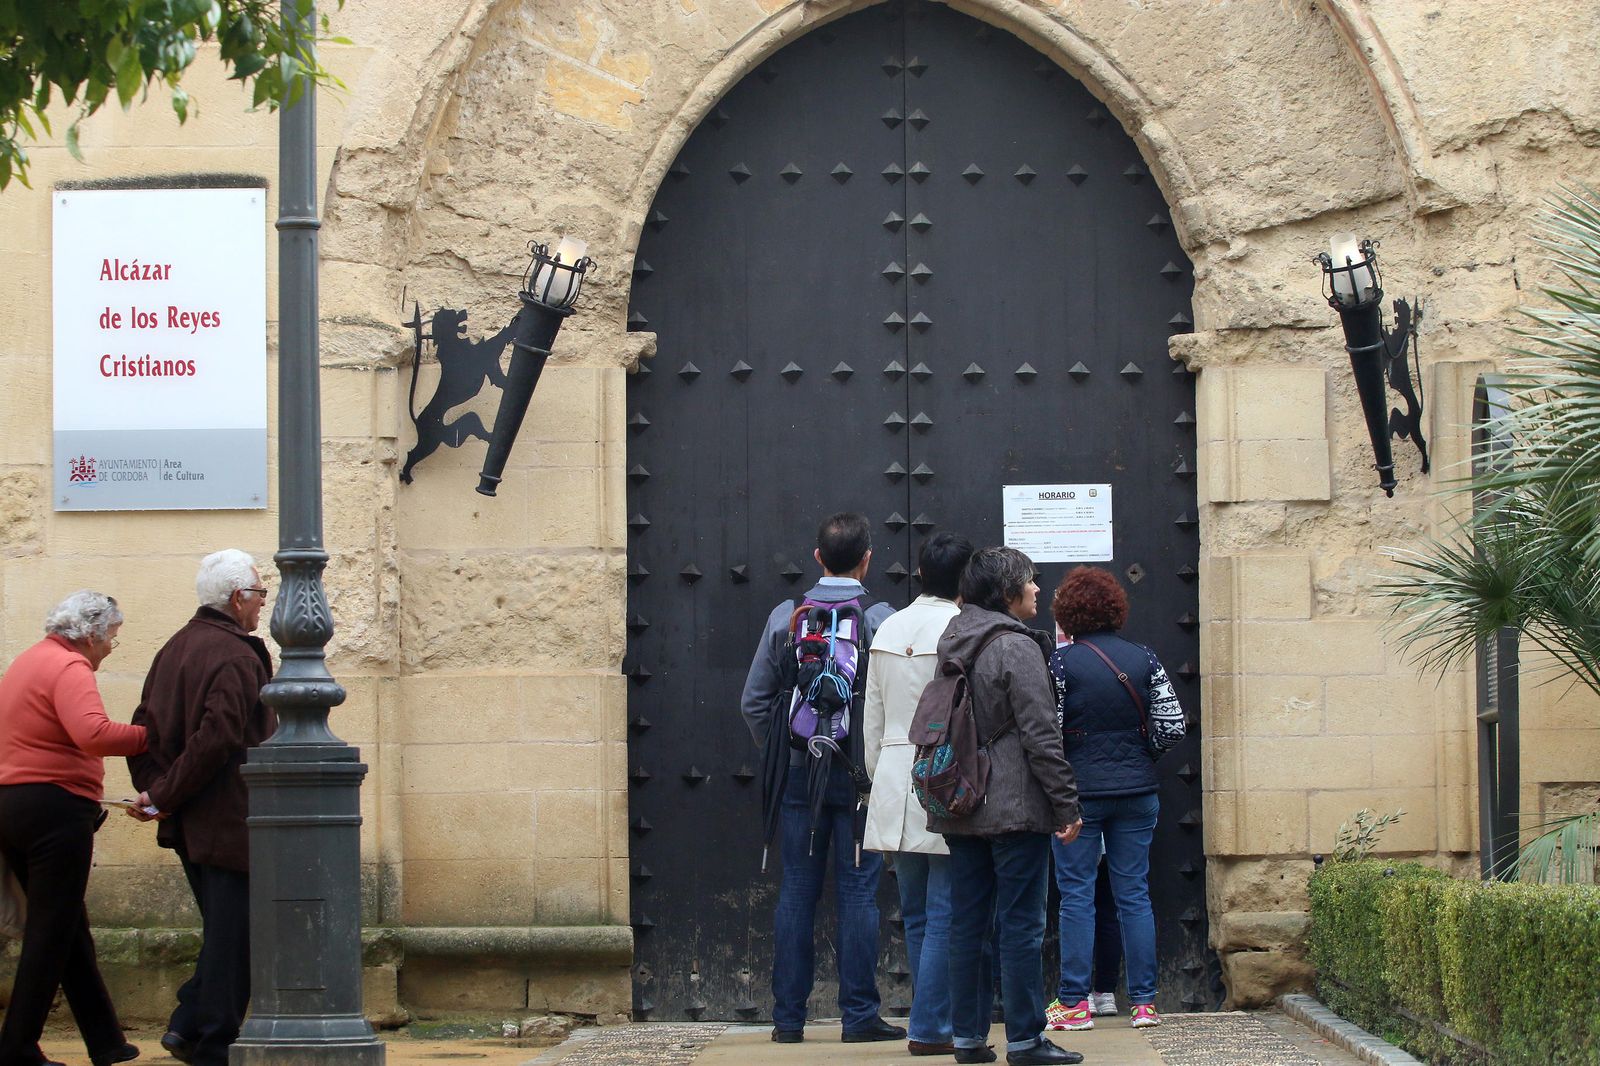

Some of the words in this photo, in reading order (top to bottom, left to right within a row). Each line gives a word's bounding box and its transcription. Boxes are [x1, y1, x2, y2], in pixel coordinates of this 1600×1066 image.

[99, 258, 172, 281] Alcázar
[99, 306, 122, 329] de
[131, 306, 158, 329] los
[167, 305, 221, 335] Reyes
[99, 354, 196, 377] Cristianos
[99, 459, 158, 469] AYUNTAMIENTO
[99, 471, 109, 481] DE
[163, 471, 173, 481] de
[175, 471, 205, 481] Cultura
[1038, 491, 1076, 500] HORARIO
